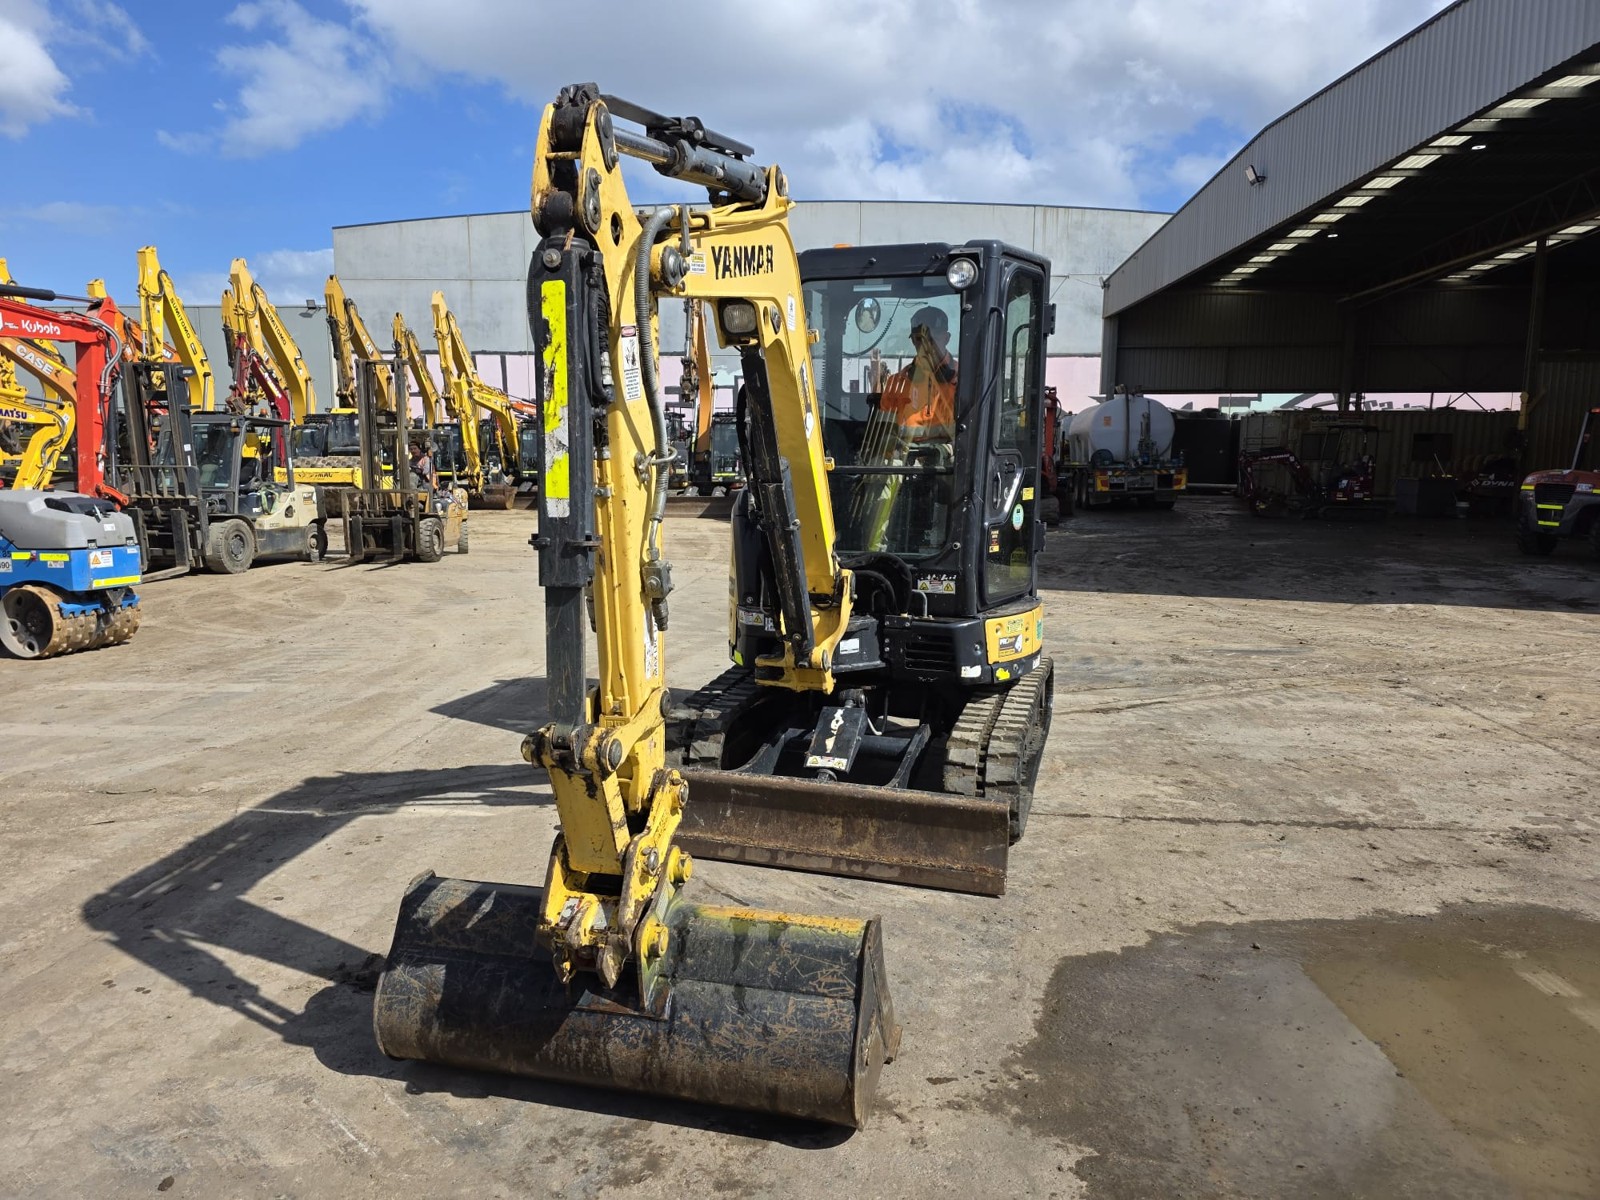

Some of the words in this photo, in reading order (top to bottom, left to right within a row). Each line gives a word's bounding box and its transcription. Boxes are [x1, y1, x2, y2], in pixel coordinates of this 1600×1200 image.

[711, 244, 773, 280] YANMAR
[21, 319, 61, 335] Kubota
[170, 297, 191, 339] SUMITOMO
[265, 307, 287, 345] SUMITOMO
[15, 344, 54, 375] CASE
